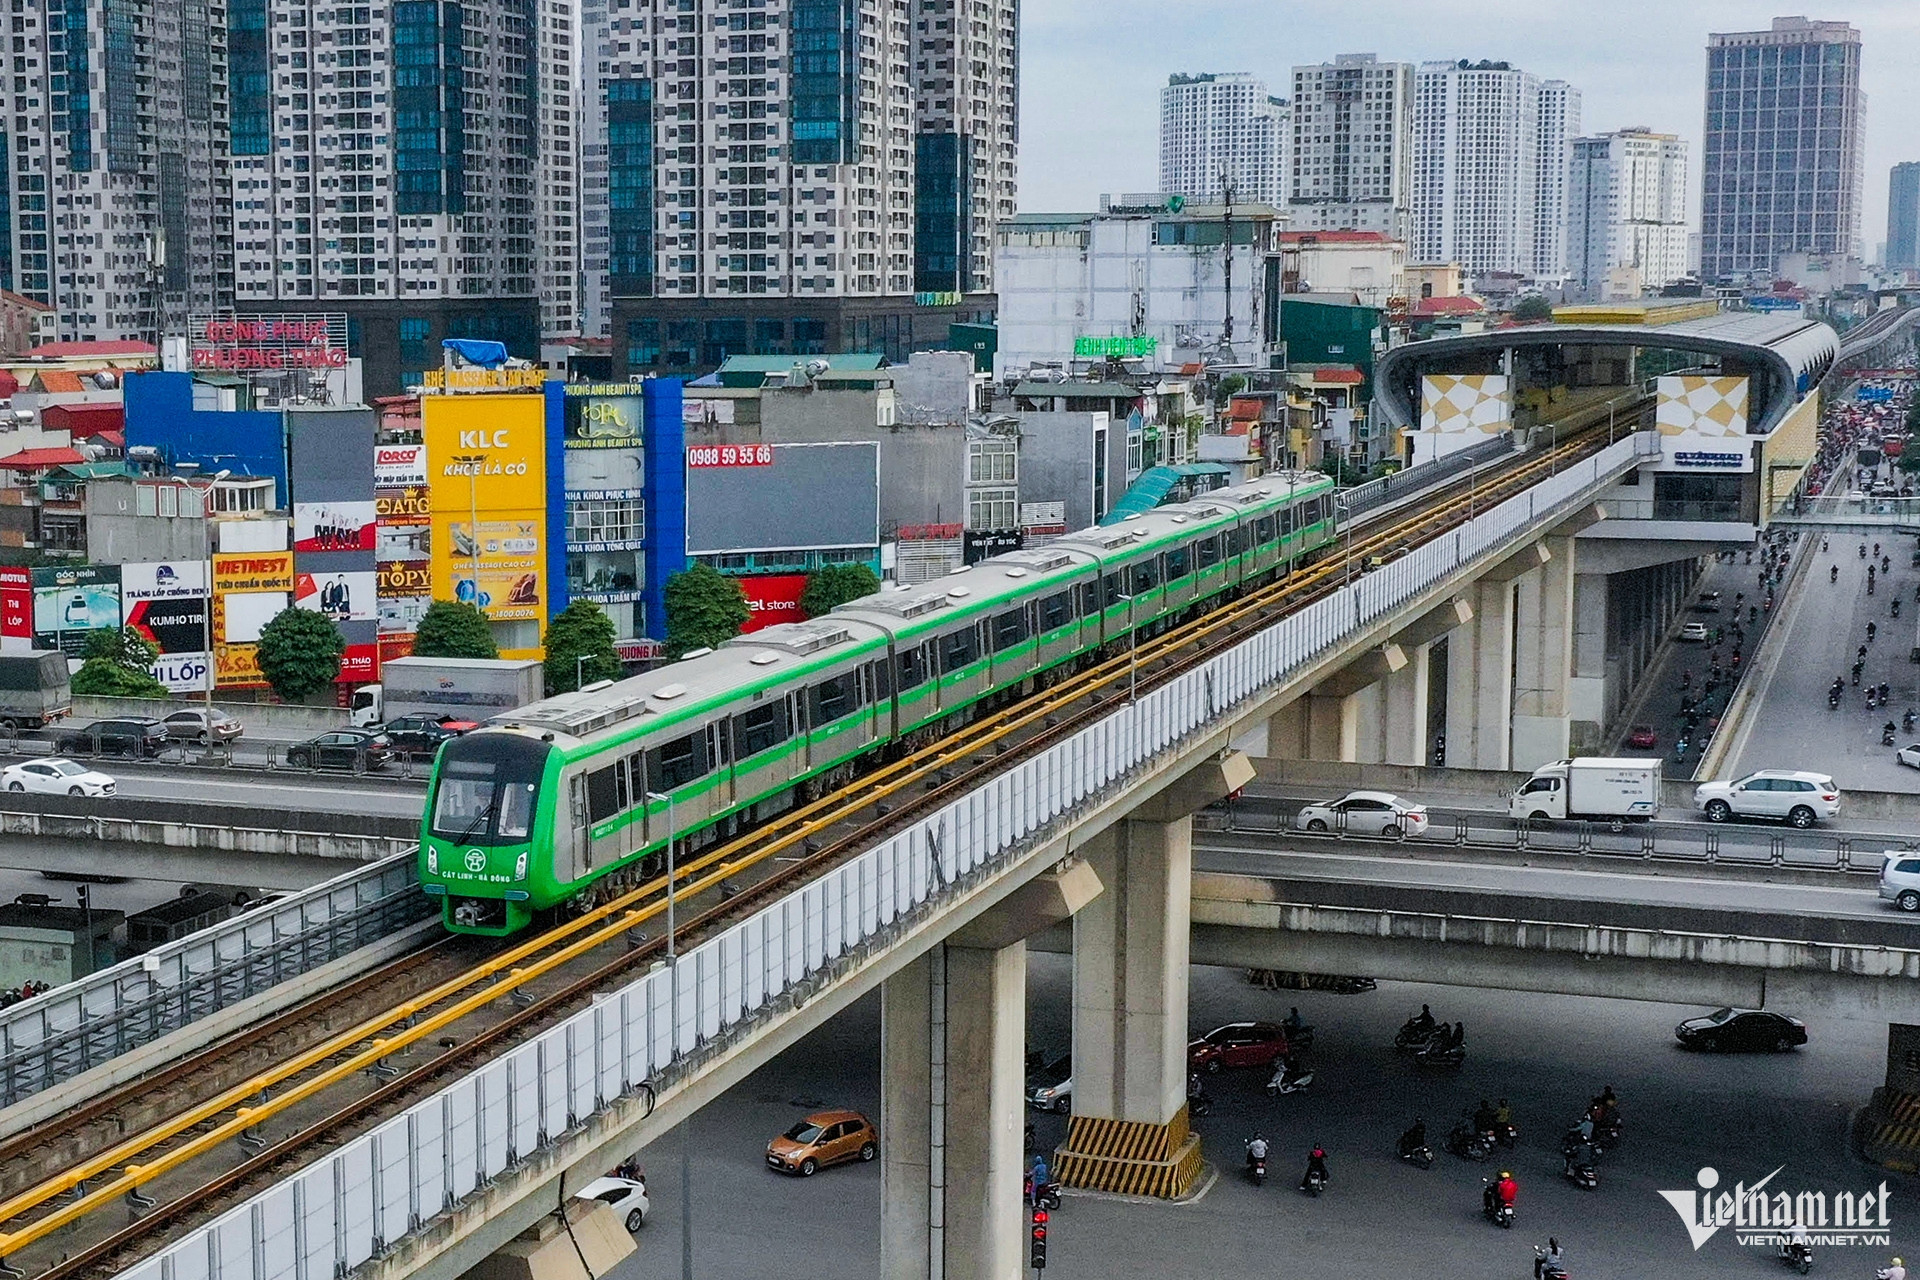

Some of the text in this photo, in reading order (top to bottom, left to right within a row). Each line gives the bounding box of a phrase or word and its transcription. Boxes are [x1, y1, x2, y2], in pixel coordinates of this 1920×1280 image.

[460, 430, 509, 448] KLC
[690, 447, 771, 465] 0988 59 55 66
[505, 457, 527, 475] CÓ
[565, 491, 580, 500] NHA
[583, 491, 604, 500] KHOA
[567, 545, 583, 553] NHA
[585, 544, 605, 552] KHOA
[216, 558, 288, 575] VIETNEST
[767, 600, 795, 610] store
[149, 615, 187, 626] KUMHO
[169, 661, 206, 681] LỐP
[457, 872, 473, 880] LINH
